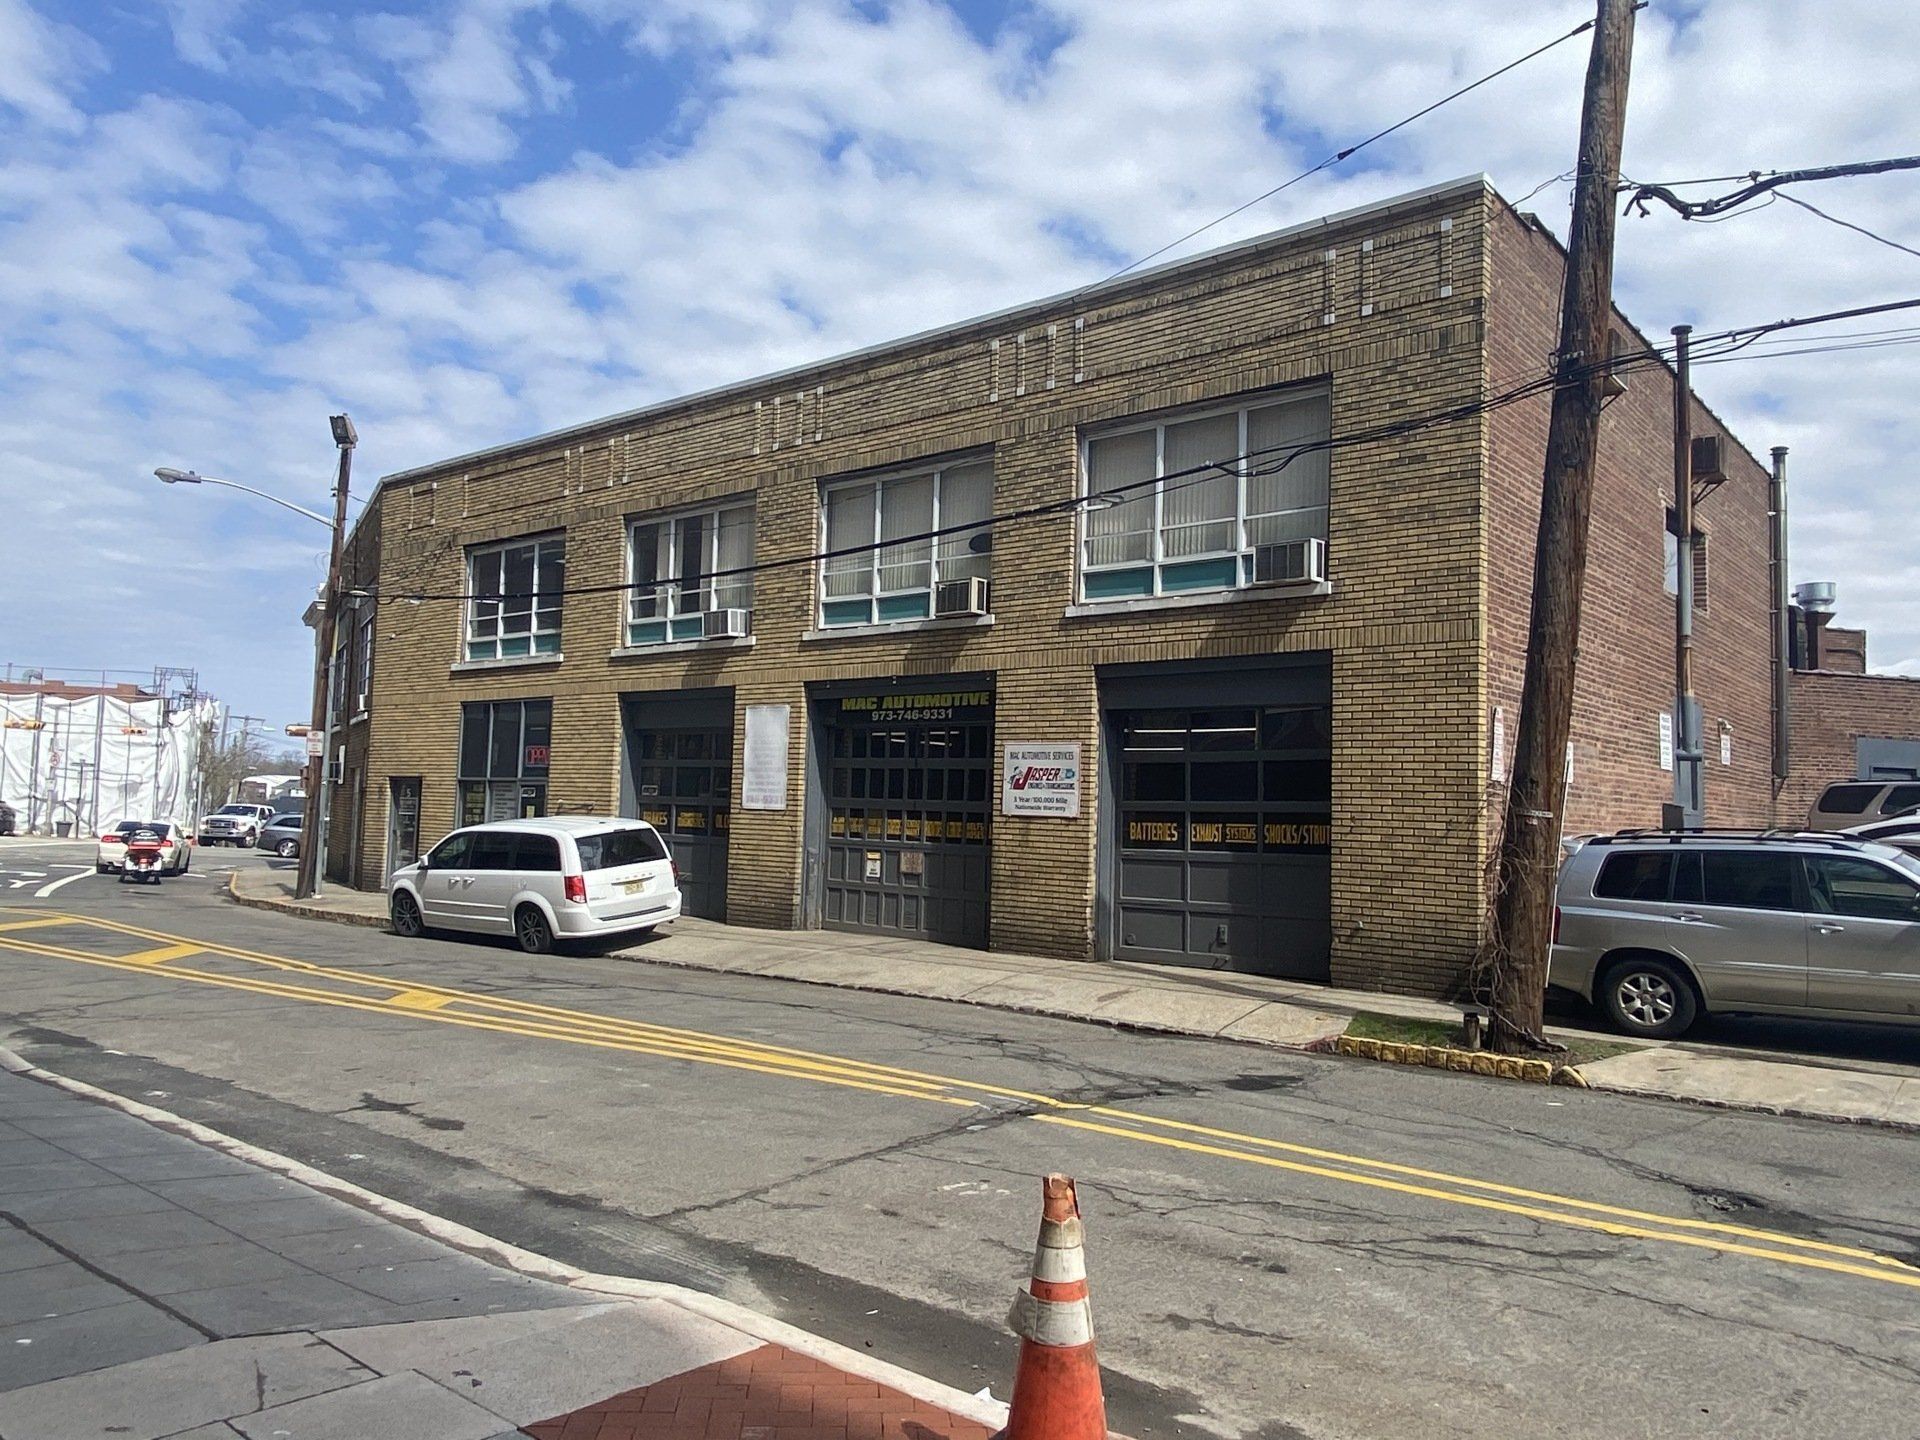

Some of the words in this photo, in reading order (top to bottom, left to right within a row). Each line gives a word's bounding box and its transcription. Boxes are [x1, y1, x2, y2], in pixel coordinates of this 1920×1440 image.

[842, 697, 877, 710] MAC
[882, 692, 990, 709] AUTOMOTIVE
[871, 709, 953, 721] 973-746-9331
[1052, 751, 1074, 760] SERVICES
[1012, 766, 1062, 791] JASPER
[1129, 822, 1178, 842] BATTERIES
[1191, 823, 1222, 843] EXHAUST
[1225, 827, 1257, 841] SYSTEMS
